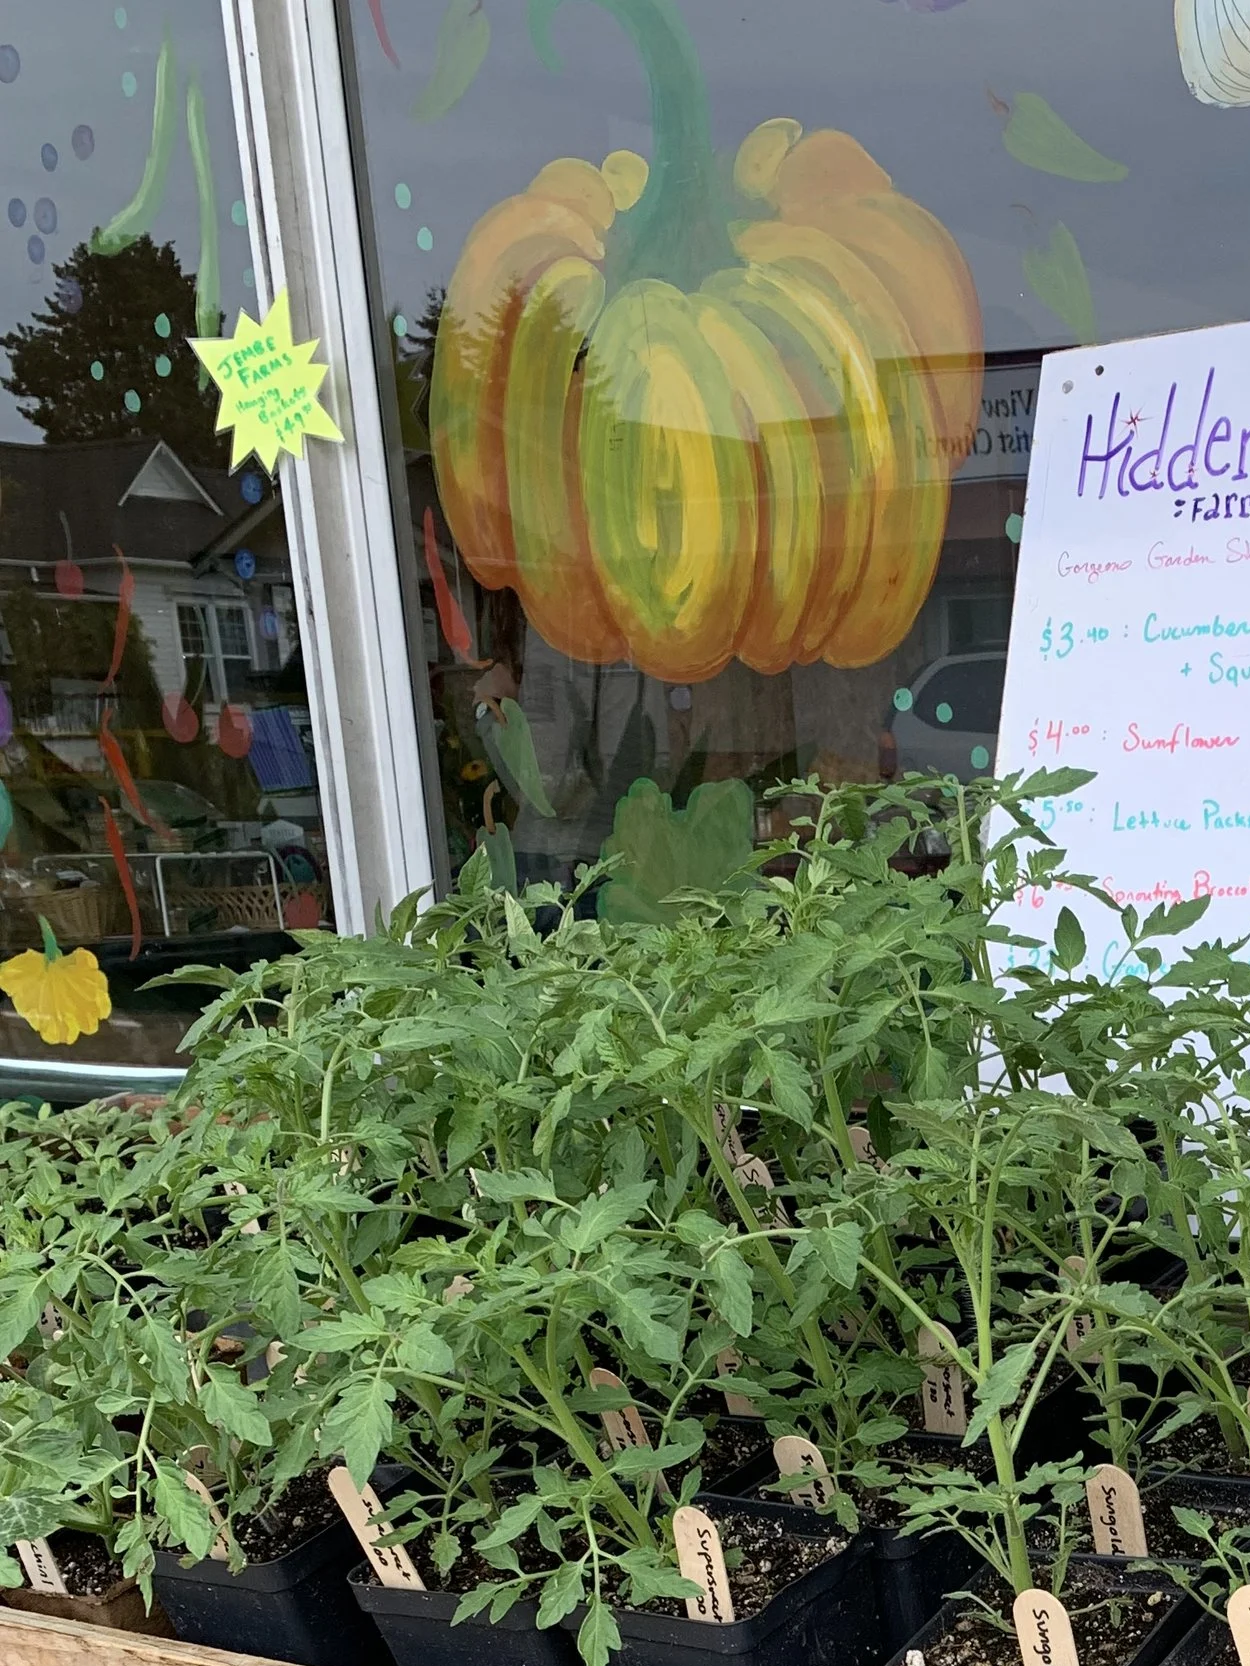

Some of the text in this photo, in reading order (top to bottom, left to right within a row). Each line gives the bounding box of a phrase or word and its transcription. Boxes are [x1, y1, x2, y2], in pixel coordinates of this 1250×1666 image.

[237, 353, 293, 389] FARMS
[1147, 541, 1215, 570] Garden
[1122, 722, 1240, 755] Sunflower
[1112, 800, 1192, 832] Lettuce
[1100, 1485, 1126, 1556] Sungold
